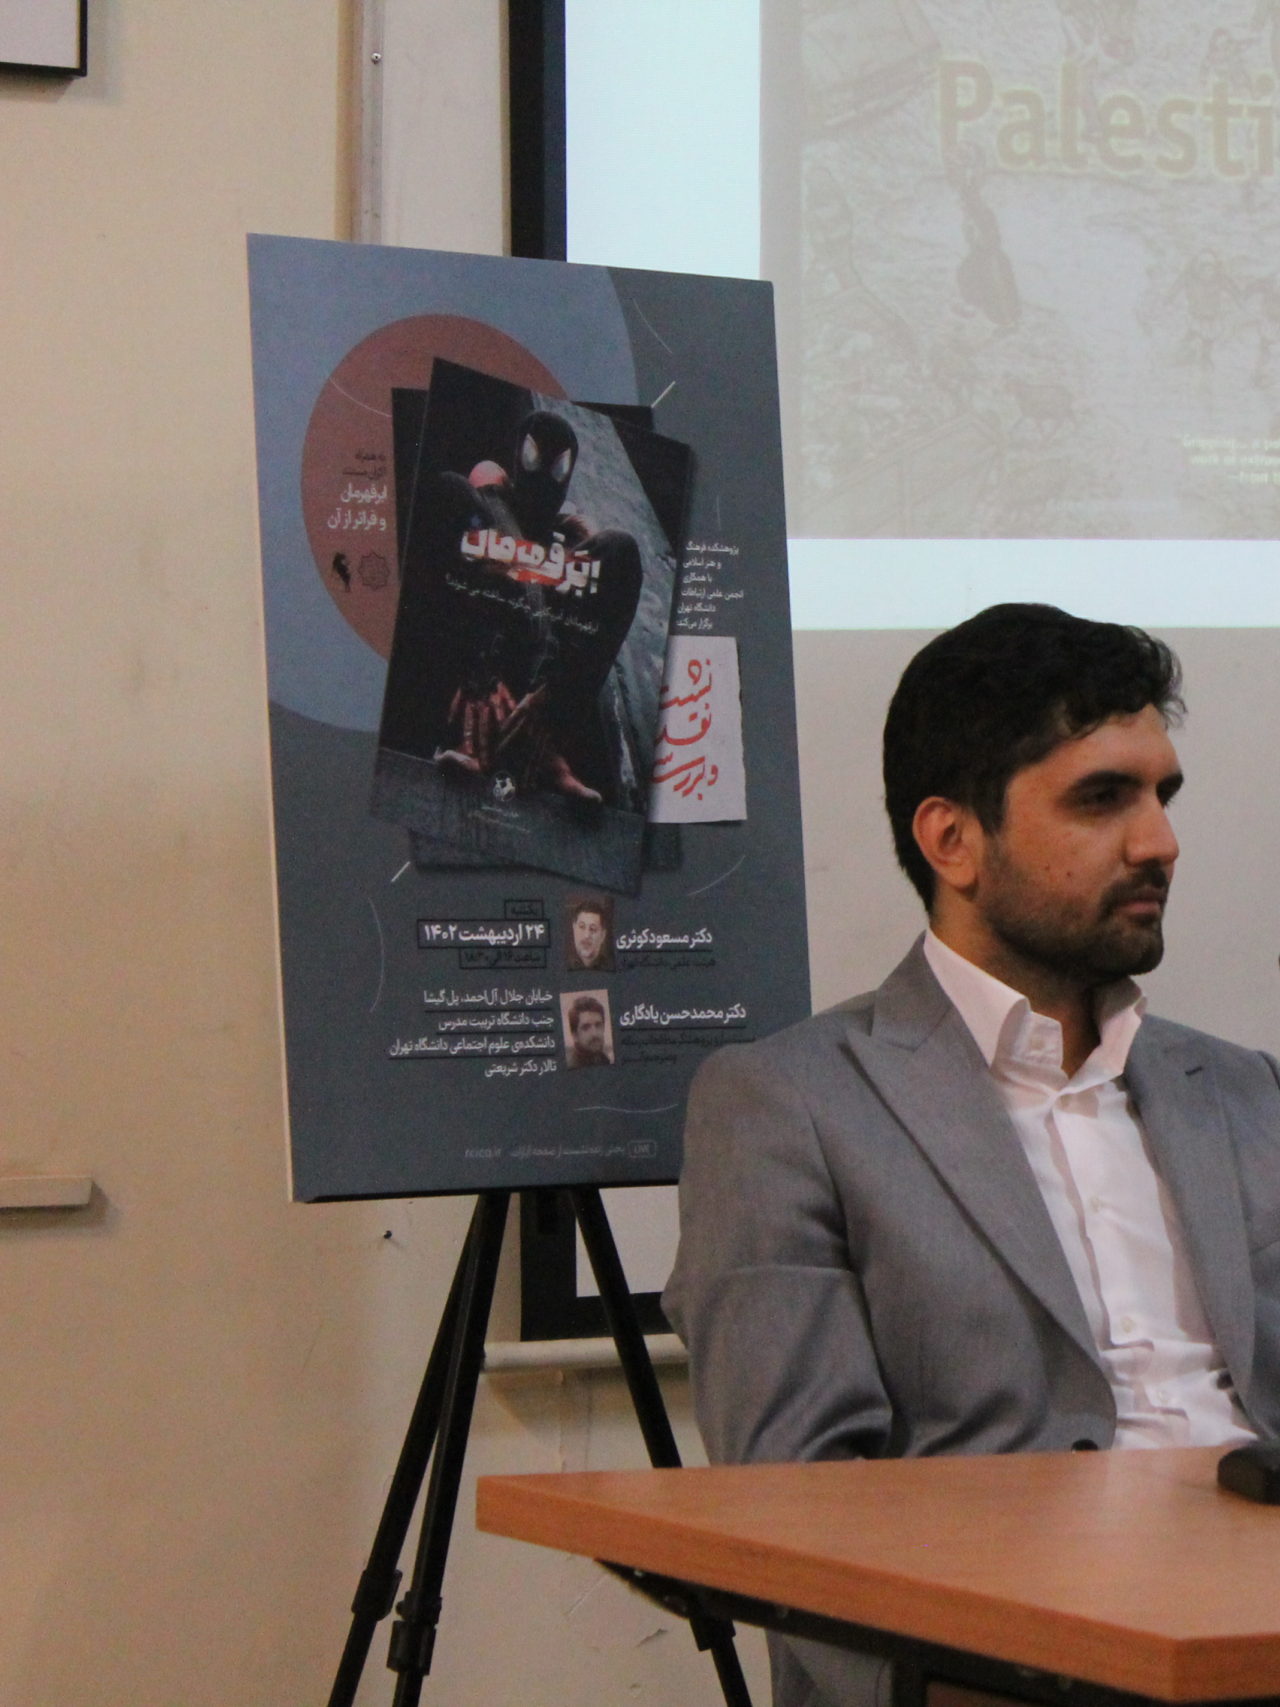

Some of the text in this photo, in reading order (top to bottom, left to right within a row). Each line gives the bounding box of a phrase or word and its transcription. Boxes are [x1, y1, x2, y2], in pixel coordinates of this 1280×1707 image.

[340, 481, 389, 506] ابرقهرمان
[327, 507, 388, 532] و فراتر از آن
[686, 540, 707, 554] فرهنگ
[683, 557, 704, 569] اسلامی
[683, 571, 707, 584] همکاری
[707, 588, 724, 600] علمی
[724, 589, 745, 601] انجمن
[677, 601, 717, 614] دانشگاه تهران
[423, 921, 545, 947] ۲۴ اردیبهشت ۱۴۰۲
[615, 925, 714, 950] دکتر مسعود کوثری
[422, 987, 446, 1004] گیشا
[501, 987, 524, 1005] جلال
[524, 987, 554, 1006] خیابان
[437, 1010, 554, 1032] جنب دانشگاه تربیت مدرس
[619, 1002, 747, 1027] دکتر محمد حسن یادگاری
[387, 1036, 414, 1057] تهران
[414, 1035, 450, 1052] دانشگاه
[450, 1036, 488, 1056] اجتماعی
[487, 1037, 511, 1055] علوم
[484, 1057, 558, 1079] تالار دکتر شریعتی
